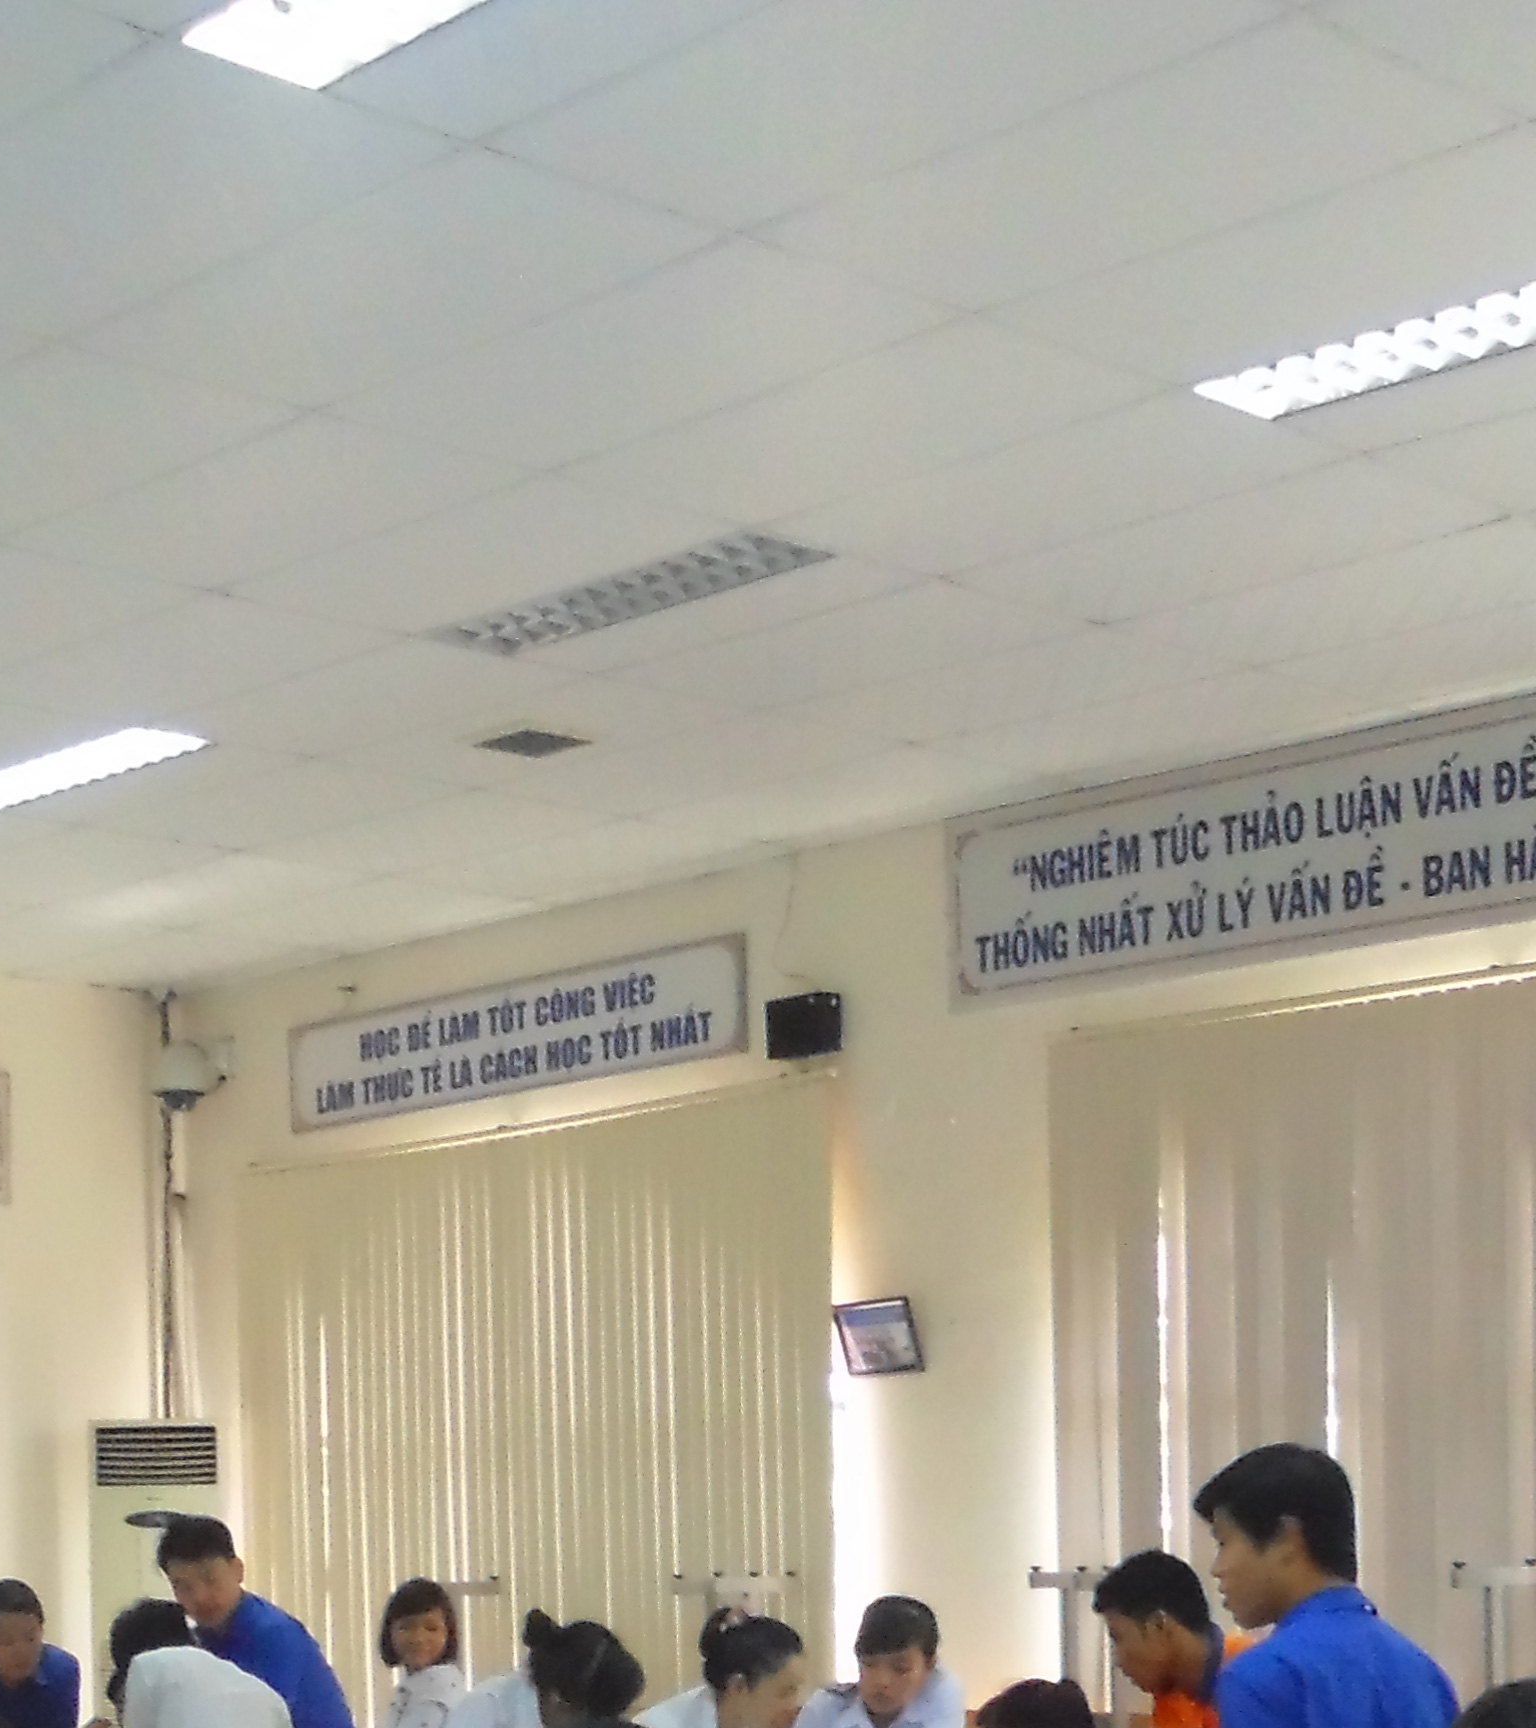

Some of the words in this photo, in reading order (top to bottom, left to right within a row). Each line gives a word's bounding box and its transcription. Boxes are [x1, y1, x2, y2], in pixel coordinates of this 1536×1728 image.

[1150, 812, 1210, 869] TÚC
[1219, 789, 1304, 855] THẢO
[1315, 775, 1402, 838] LUẬN
[1413, 752, 1481, 819] VẤN
[975, 910, 1068, 974] THỐNG
[1078, 891, 1154, 957] NHẤT
[1166, 880, 1207, 942] XỬ
[1218, 876, 1254, 933] LÝ
[1267, 860, 1330, 924] VẤN
[1342, 845, 1385, 911] ĐỀ
[1423, 845, 1491, 897] BAN
